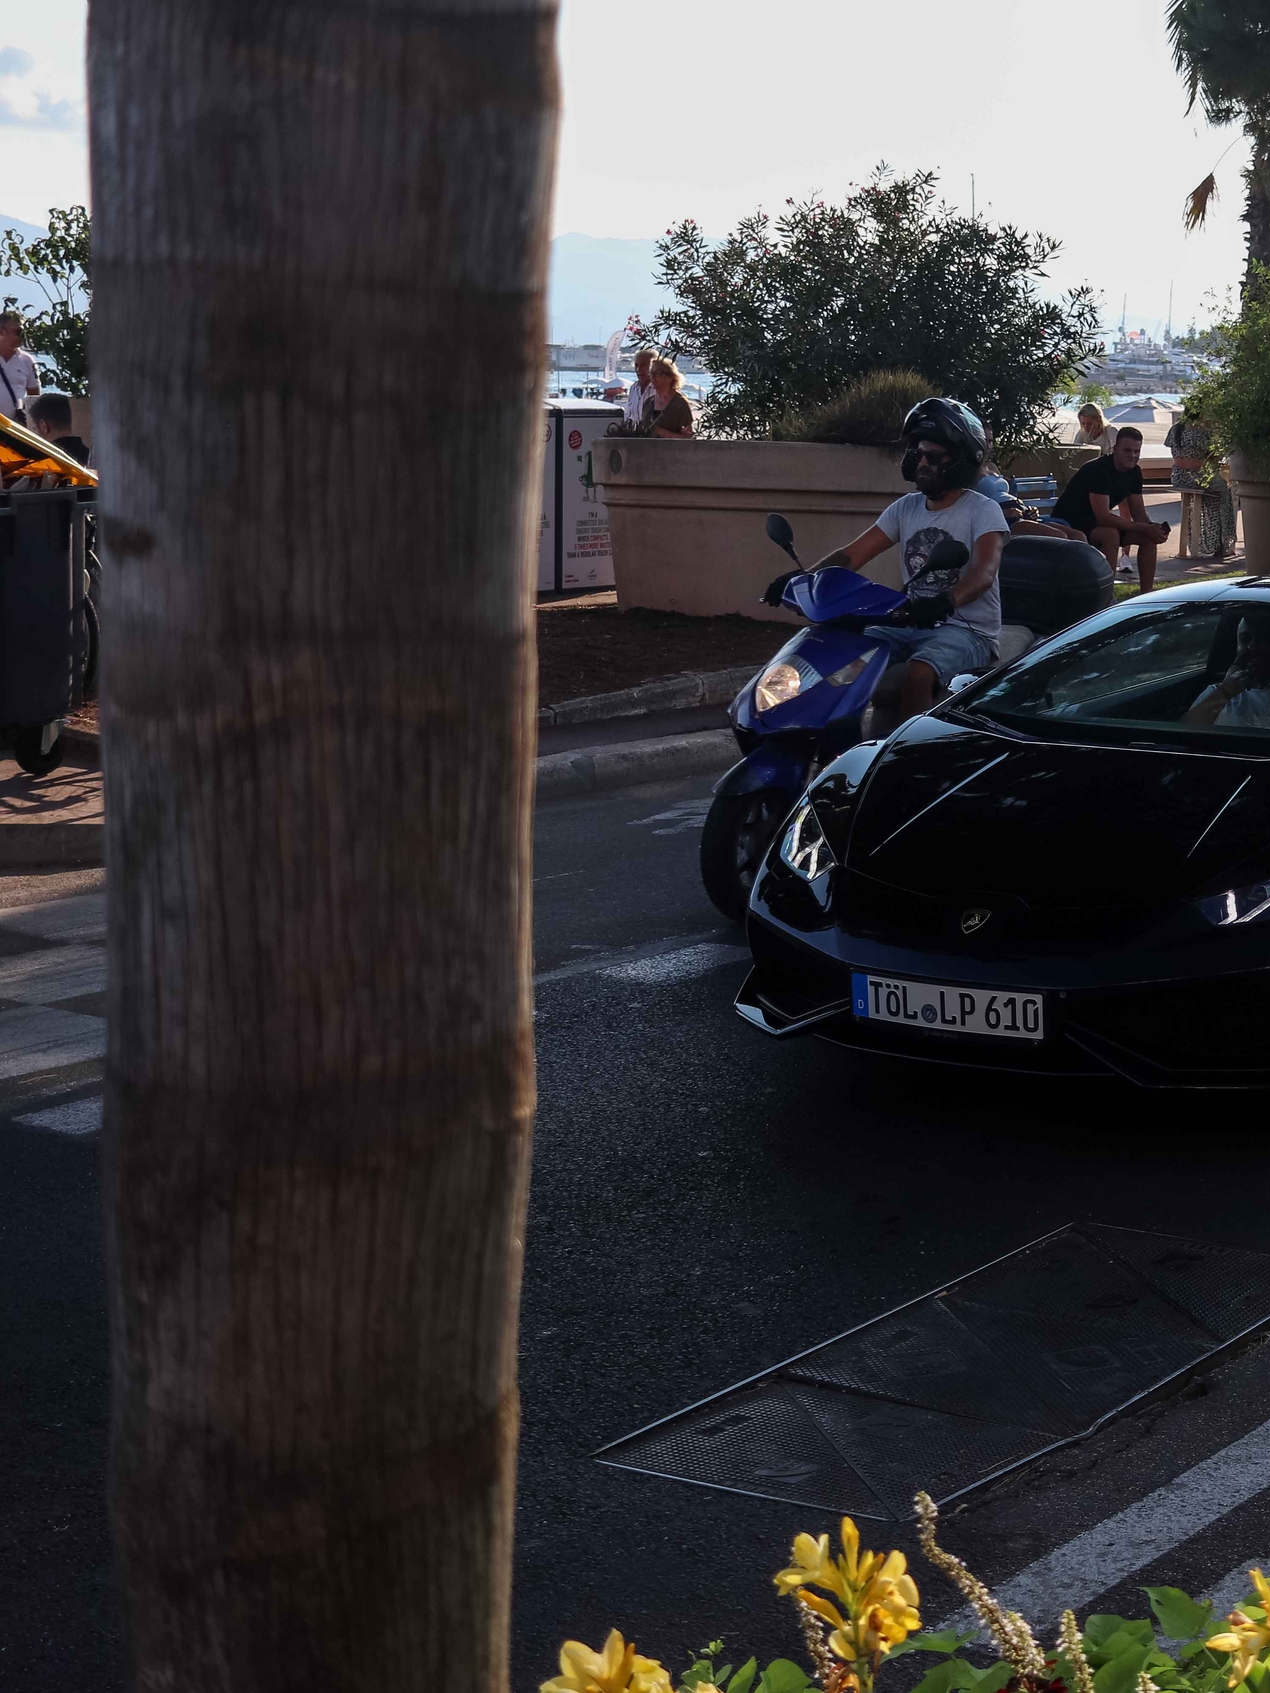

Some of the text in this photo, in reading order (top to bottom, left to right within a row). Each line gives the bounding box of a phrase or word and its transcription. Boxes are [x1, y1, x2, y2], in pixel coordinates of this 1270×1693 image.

[869, 980, 918, 1020] TÖL
[939, 990, 976, 1026] LP
[984, 995, 1040, 1033] 610
